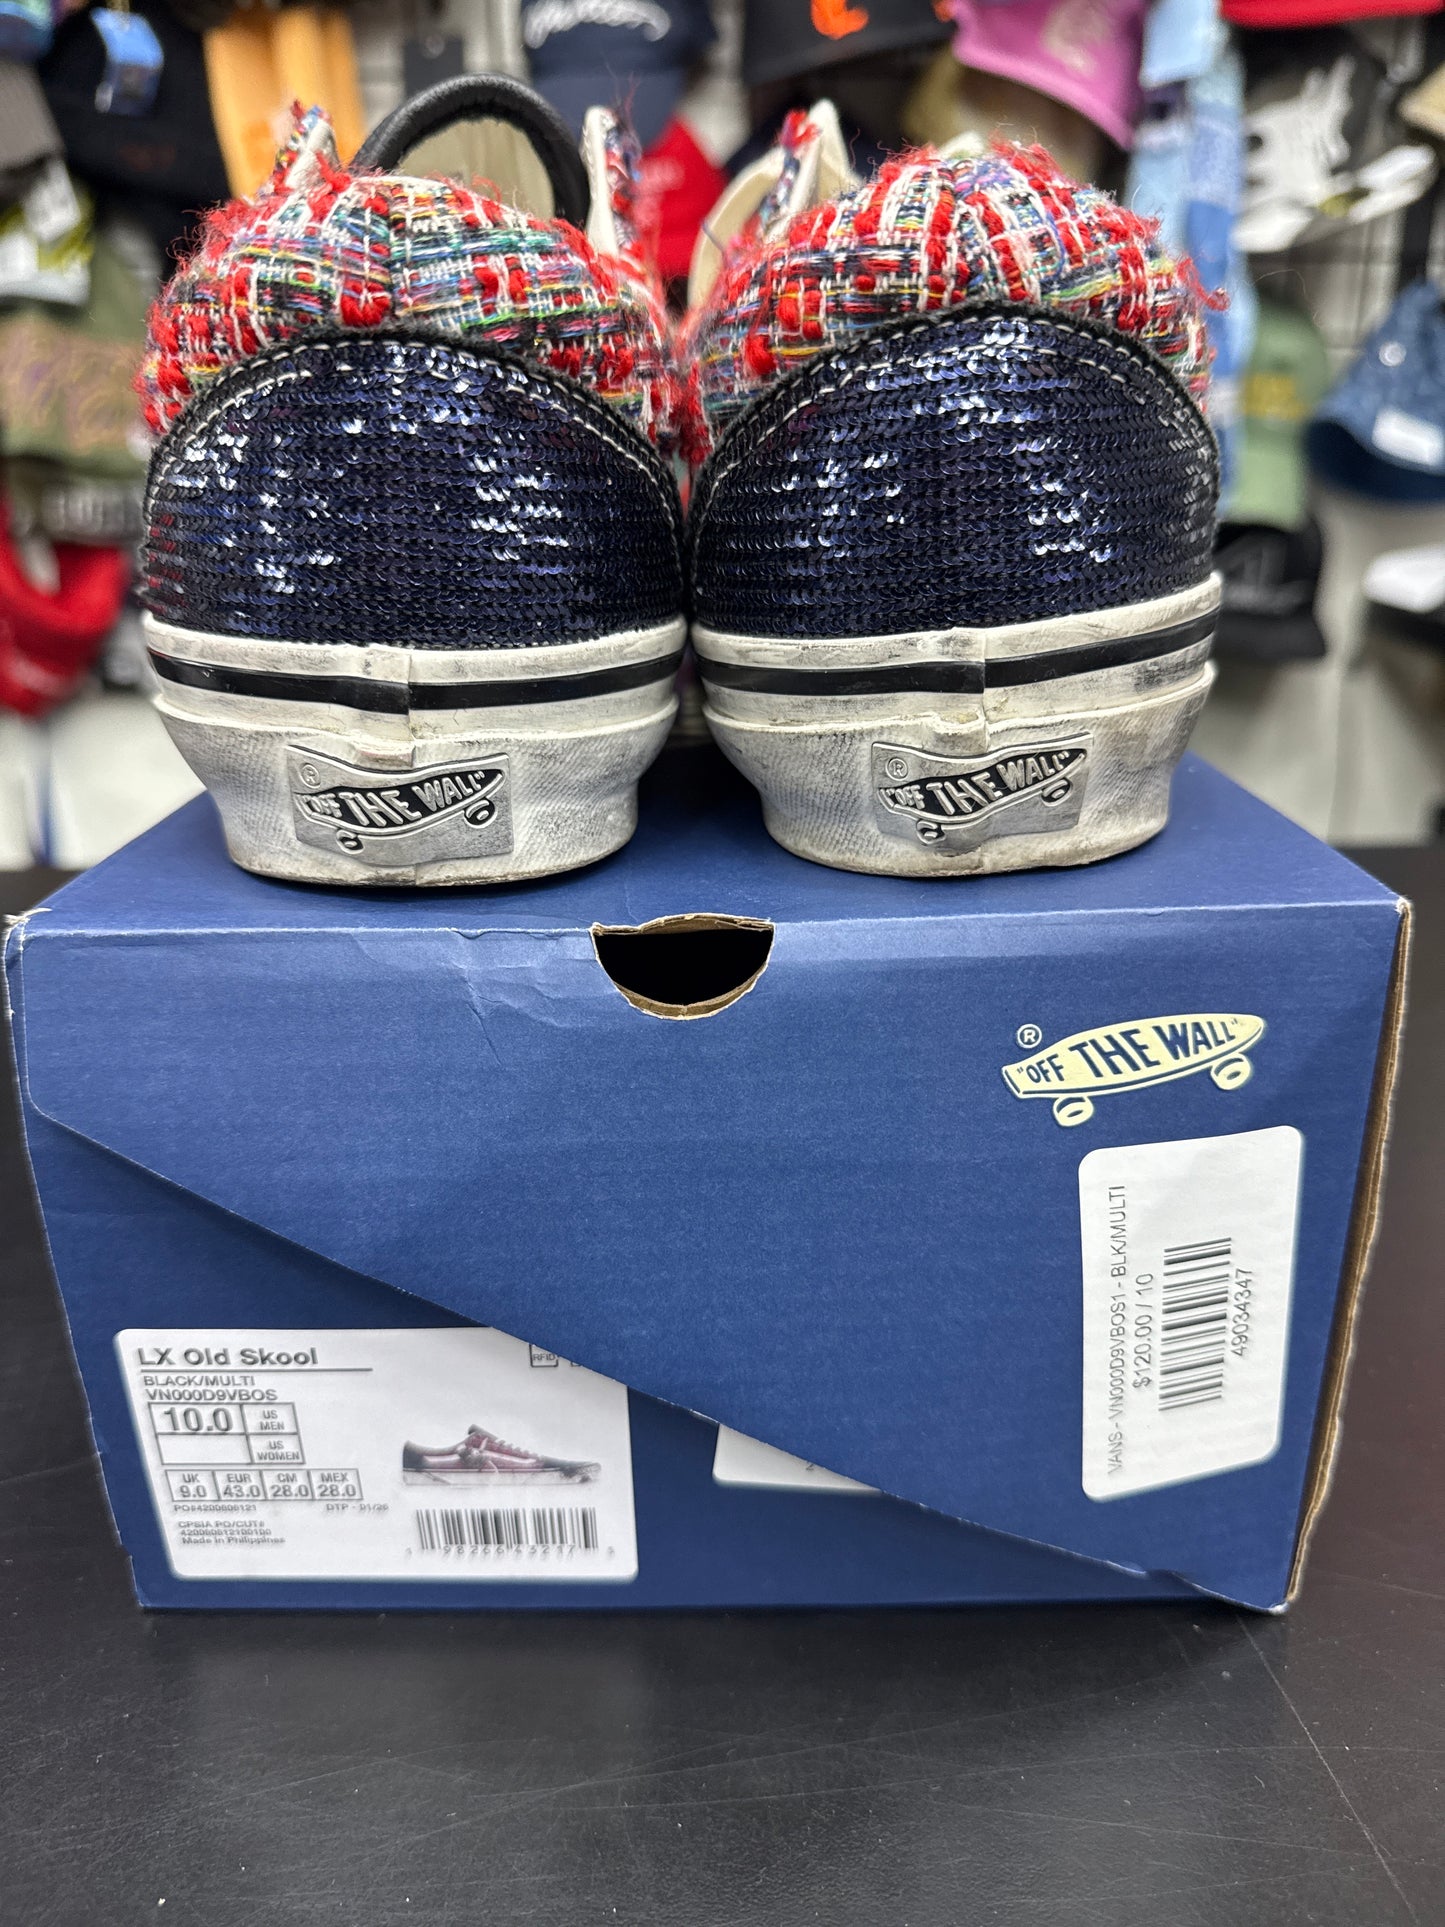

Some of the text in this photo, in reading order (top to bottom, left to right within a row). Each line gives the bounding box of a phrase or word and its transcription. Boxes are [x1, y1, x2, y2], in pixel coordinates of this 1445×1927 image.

[925, 771, 1003, 816] THE
[338, 790, 423, 827] THE
[1016, 1017, 1239, 1085] "OFF THE WALL"
[1108, 1185, 1127, 1278] BLK/MULTI
[1135, 1273, 1153, 1296] 10
[1230, 1268, 1253, 1357] 49034347
[137, 1346, 319, 1366] LX Old Skool
[533, 1352, 556, 1361] RFID
[1131, 1314, 1153, 1389] $120.00
[143, 1375, 256, 1387] BLACK/MULTI
[163, 1407, 234, 1432] 10.0
[262, 1409, 278, 1420] US
[260, 1421, 285, 1431] MEN
[268, 1440, 285, 1450] US
[1107, 1431, 1123, 1475] VANS
[257, 1451, 300, 1461] WOMEN
[182, 1473, 349, 1483] UK EUR CM MEX
[180, 1484, 357, 1498] 9.0 43.0 28.0 28.0
[182, 1537, 213, 1545] Made
[227, 1536, 286, 1545] Philippines
